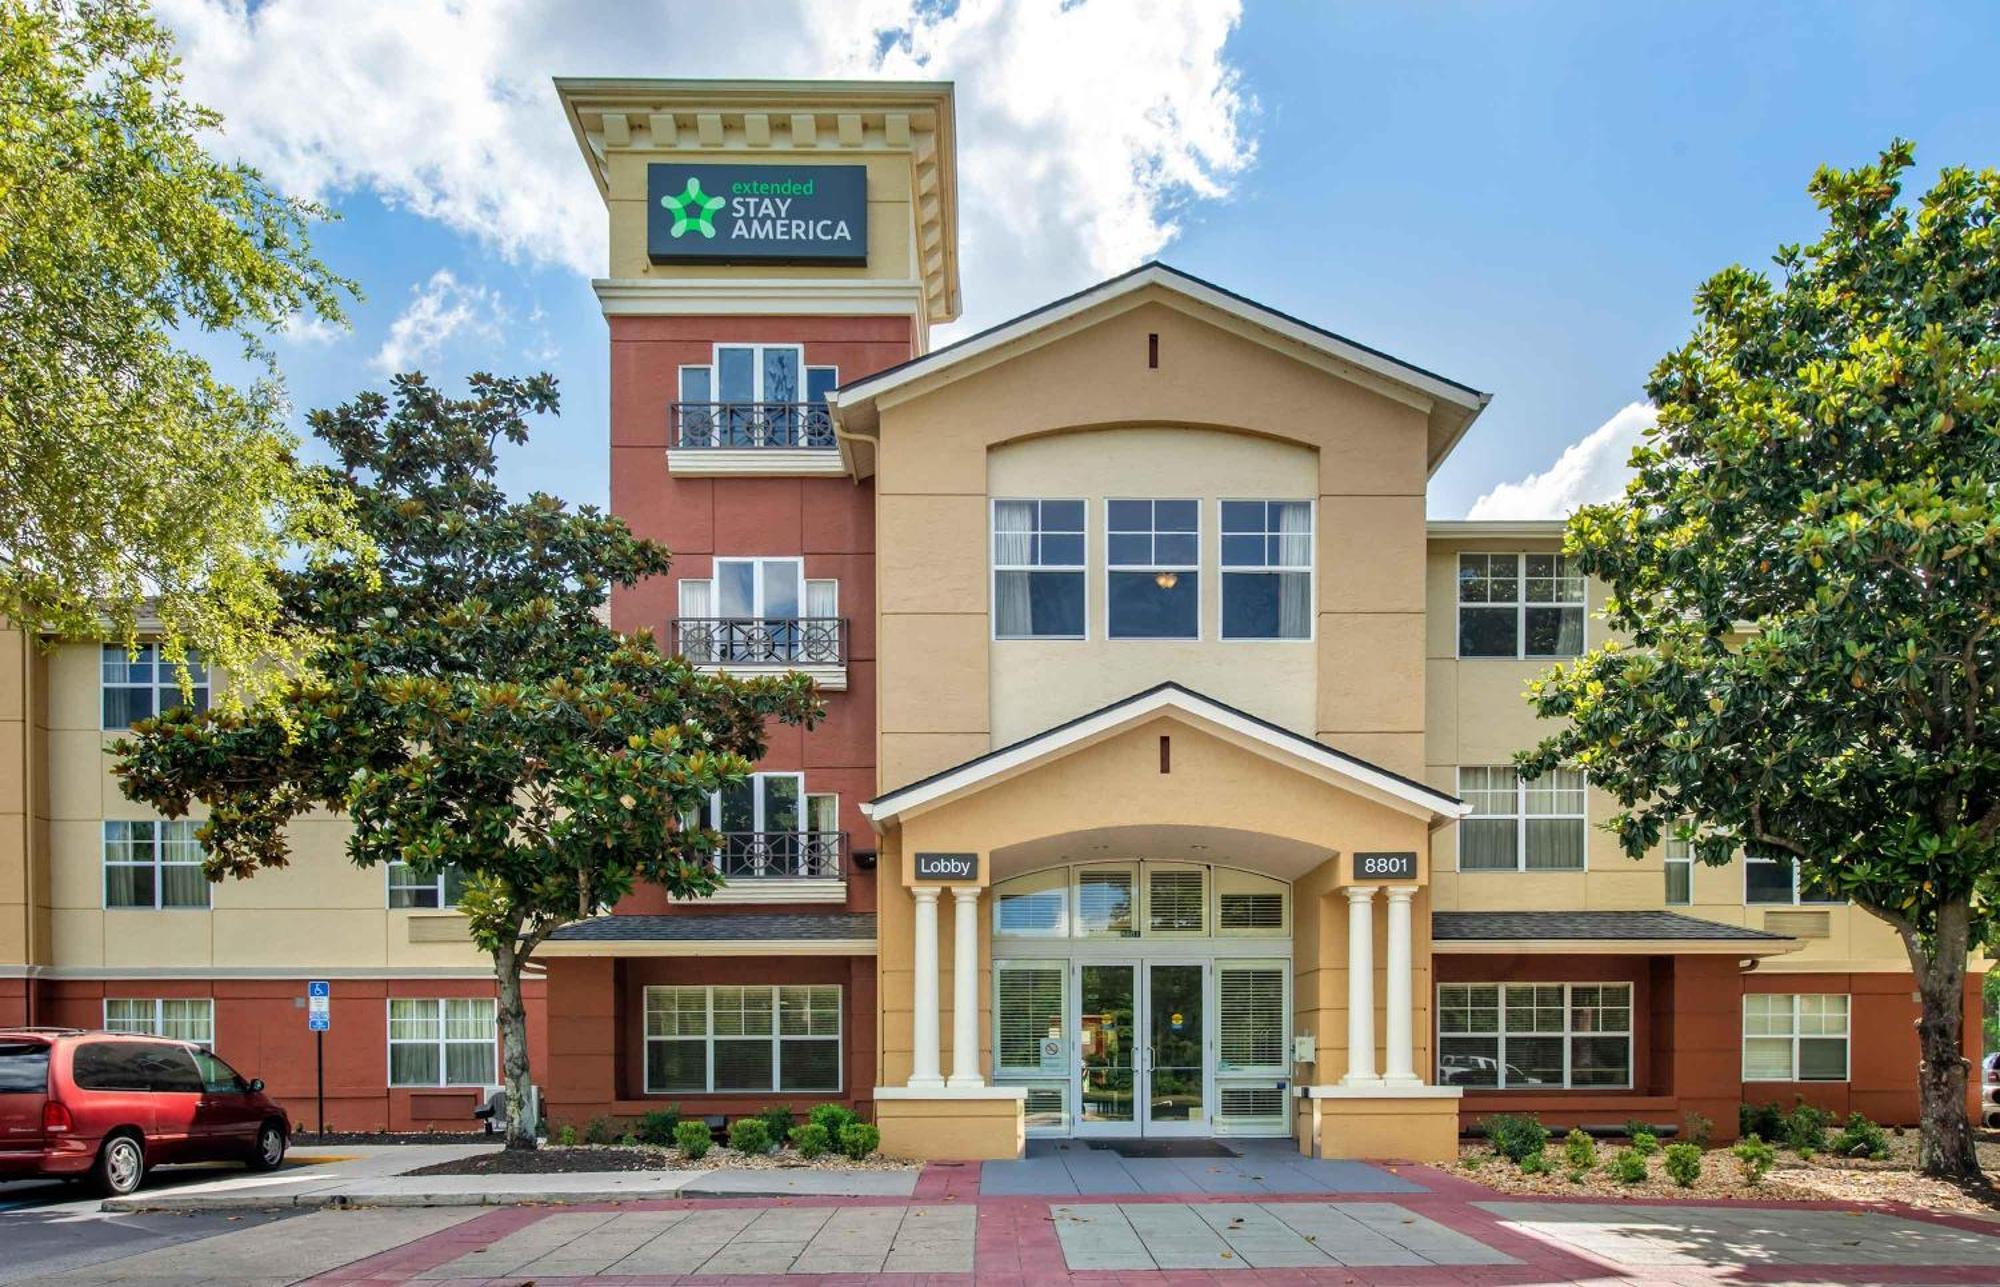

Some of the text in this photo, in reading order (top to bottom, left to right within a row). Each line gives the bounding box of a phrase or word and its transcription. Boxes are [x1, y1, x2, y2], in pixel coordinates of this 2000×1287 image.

[732, 179, 814, 195] extended
[731, 198, 792, 218] STAY
[731, 220, 851, 241] AMERICA
[921, 858, 971, 876] Lobby
[1365, 858, 1407, 873] 8801
